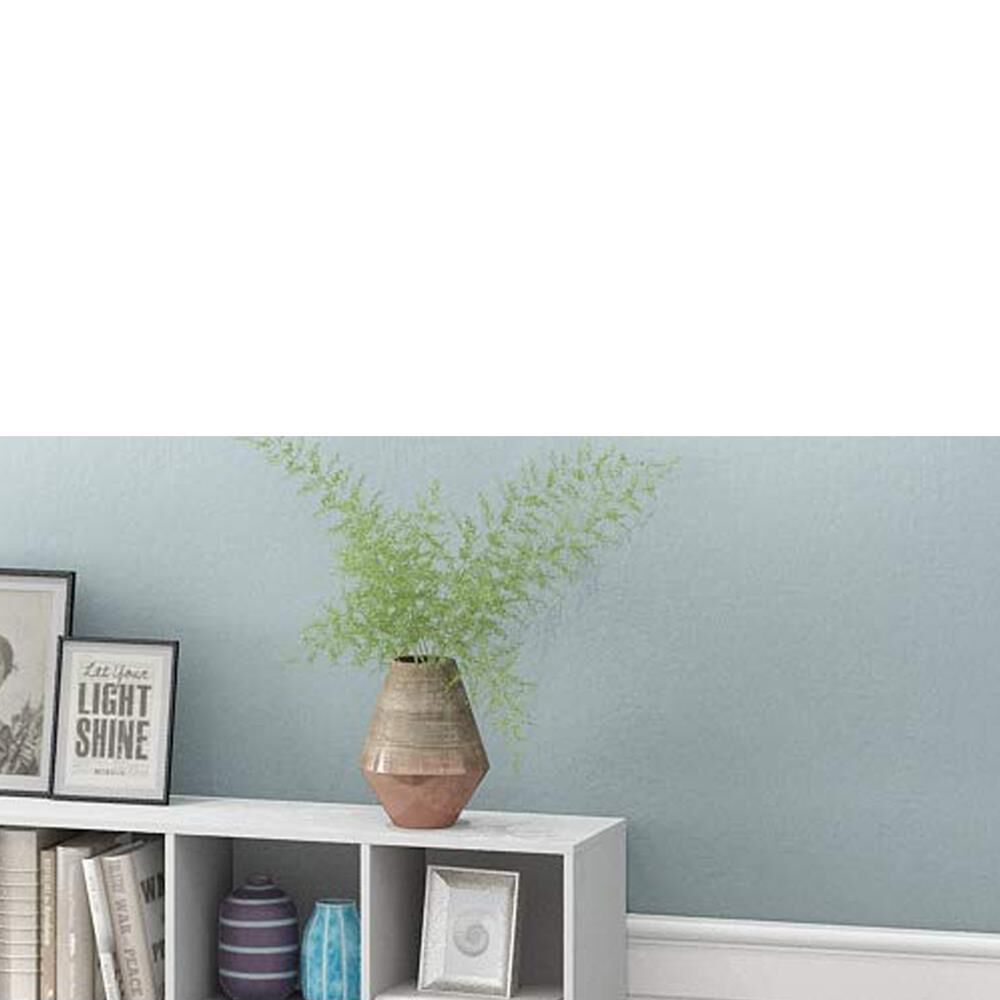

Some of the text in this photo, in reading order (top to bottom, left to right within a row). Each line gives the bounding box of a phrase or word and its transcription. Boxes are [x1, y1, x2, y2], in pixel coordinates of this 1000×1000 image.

[78, 682, 152, 717] LIGHT
[75, 717, 150, 760] SHINE
[124, 948, 143, 998] PEACE
